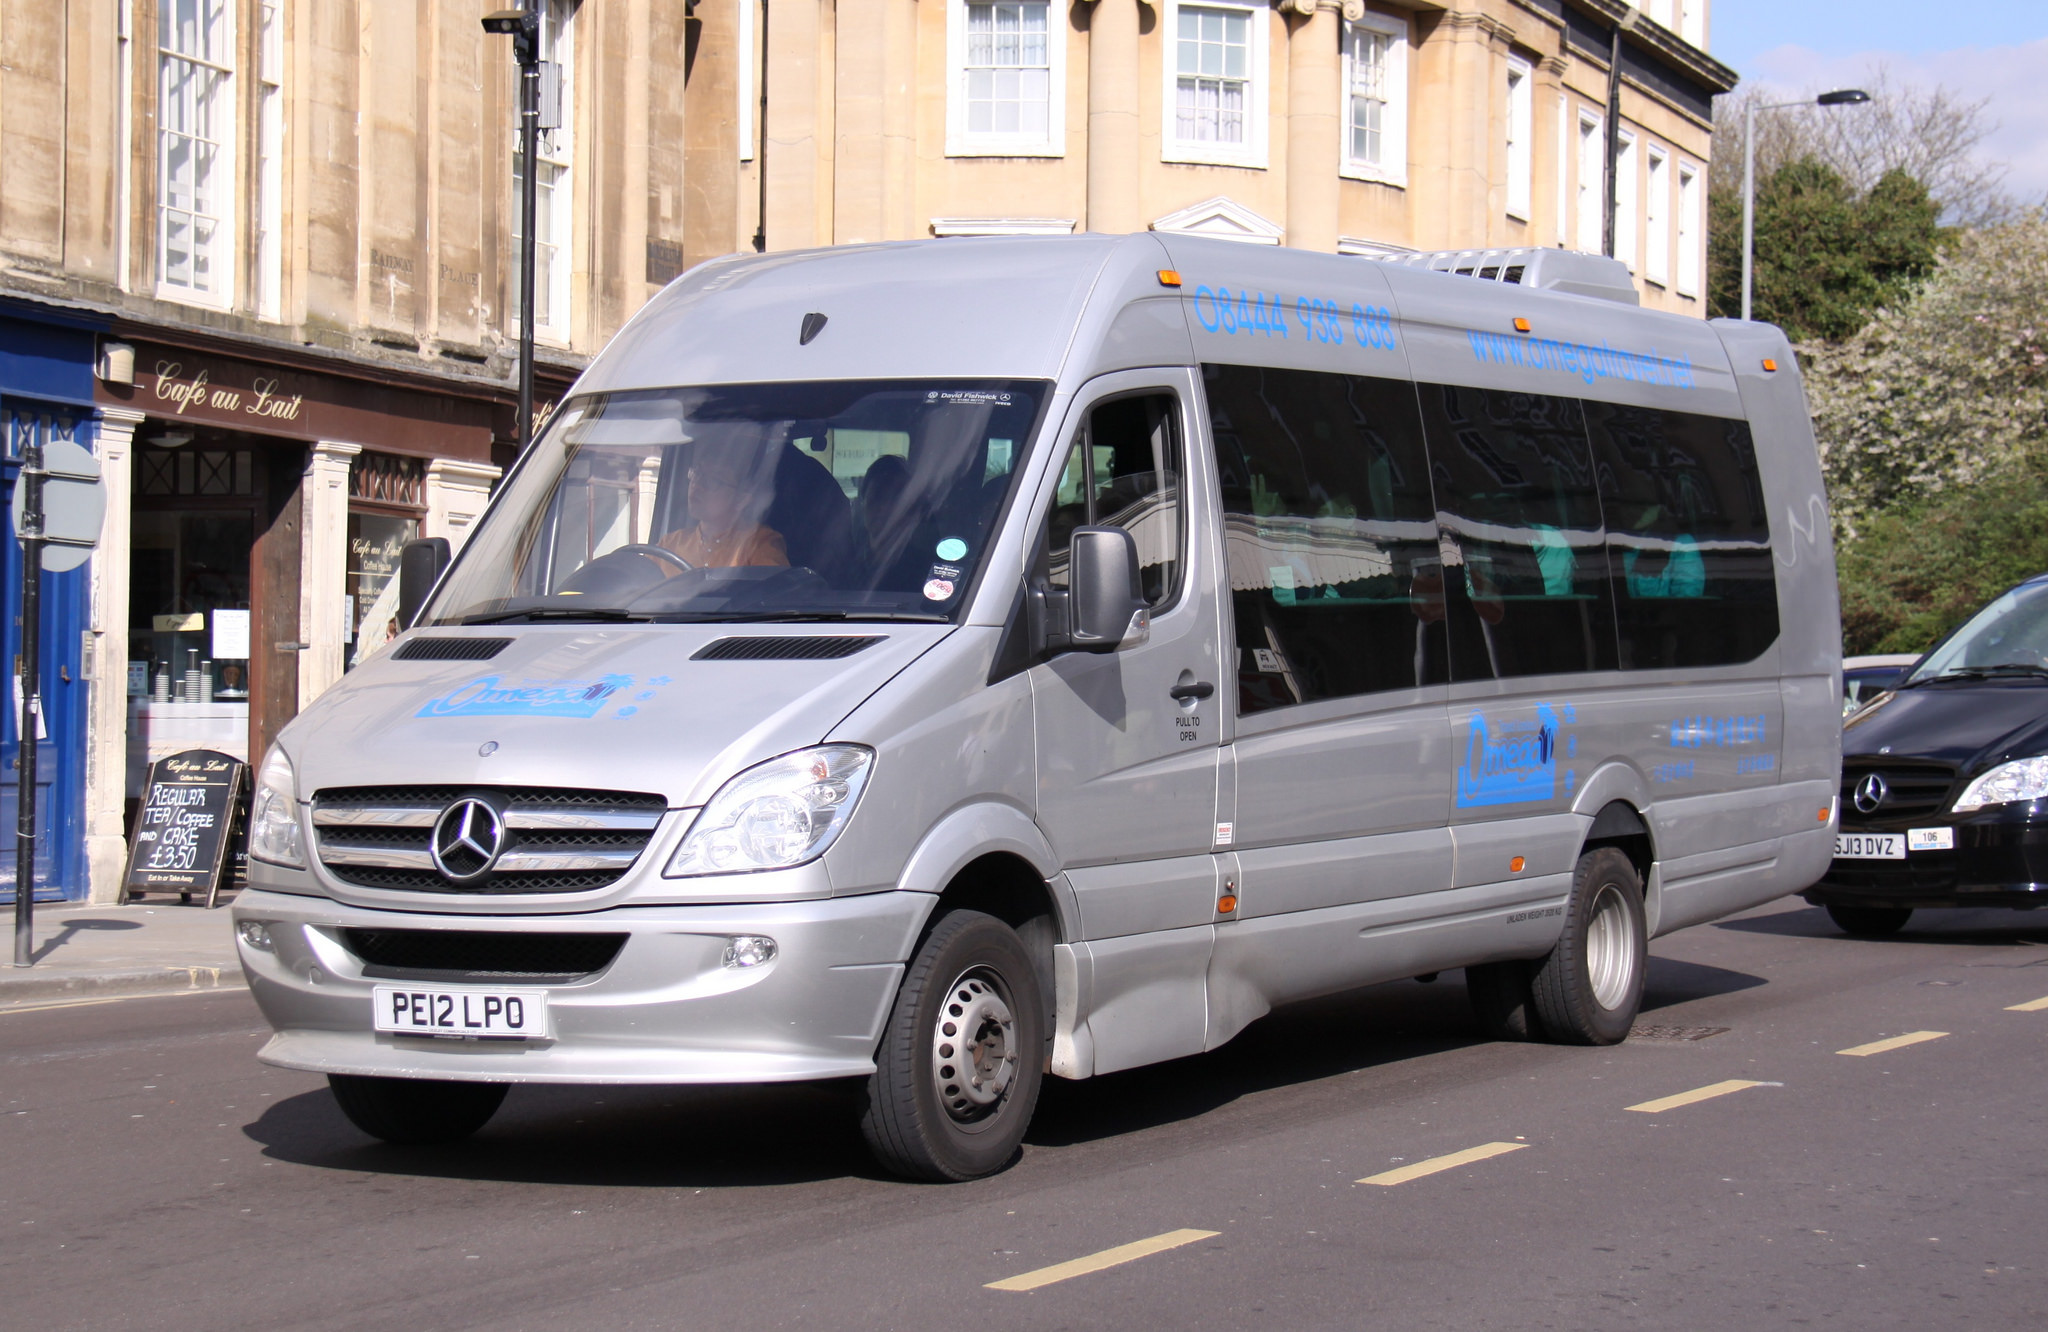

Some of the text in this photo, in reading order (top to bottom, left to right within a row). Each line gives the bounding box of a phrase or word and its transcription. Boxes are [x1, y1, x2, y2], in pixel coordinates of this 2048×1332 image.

[370, 248, 478, 286] RAILWAY PLACE
[1194, 284, 1395, 351] 08444 938 888
[1467, 329, 1696, 390] www.omegatravel.net
[156, 360, 302, 420] Café au Lait
[941, 392, 998, 400] David Fishwick
[432, 676, 591, 713] Omega
[1175, 716, 1200, 727] PULL TO
[1180, 731, 1197, 741] OPEN
[1465, 708, 1544, 800] Omega
[148, 785, 206, 807] REGULAR
[139, 827, 200, 846] AND CAKE
[1835, 838, 1861, 854] SJ13
[1866, 838, 1894, 855] DVZ
[1923, 832, 1937, 842] 106
[392, 992, 524, 1029] PE12 LPO
